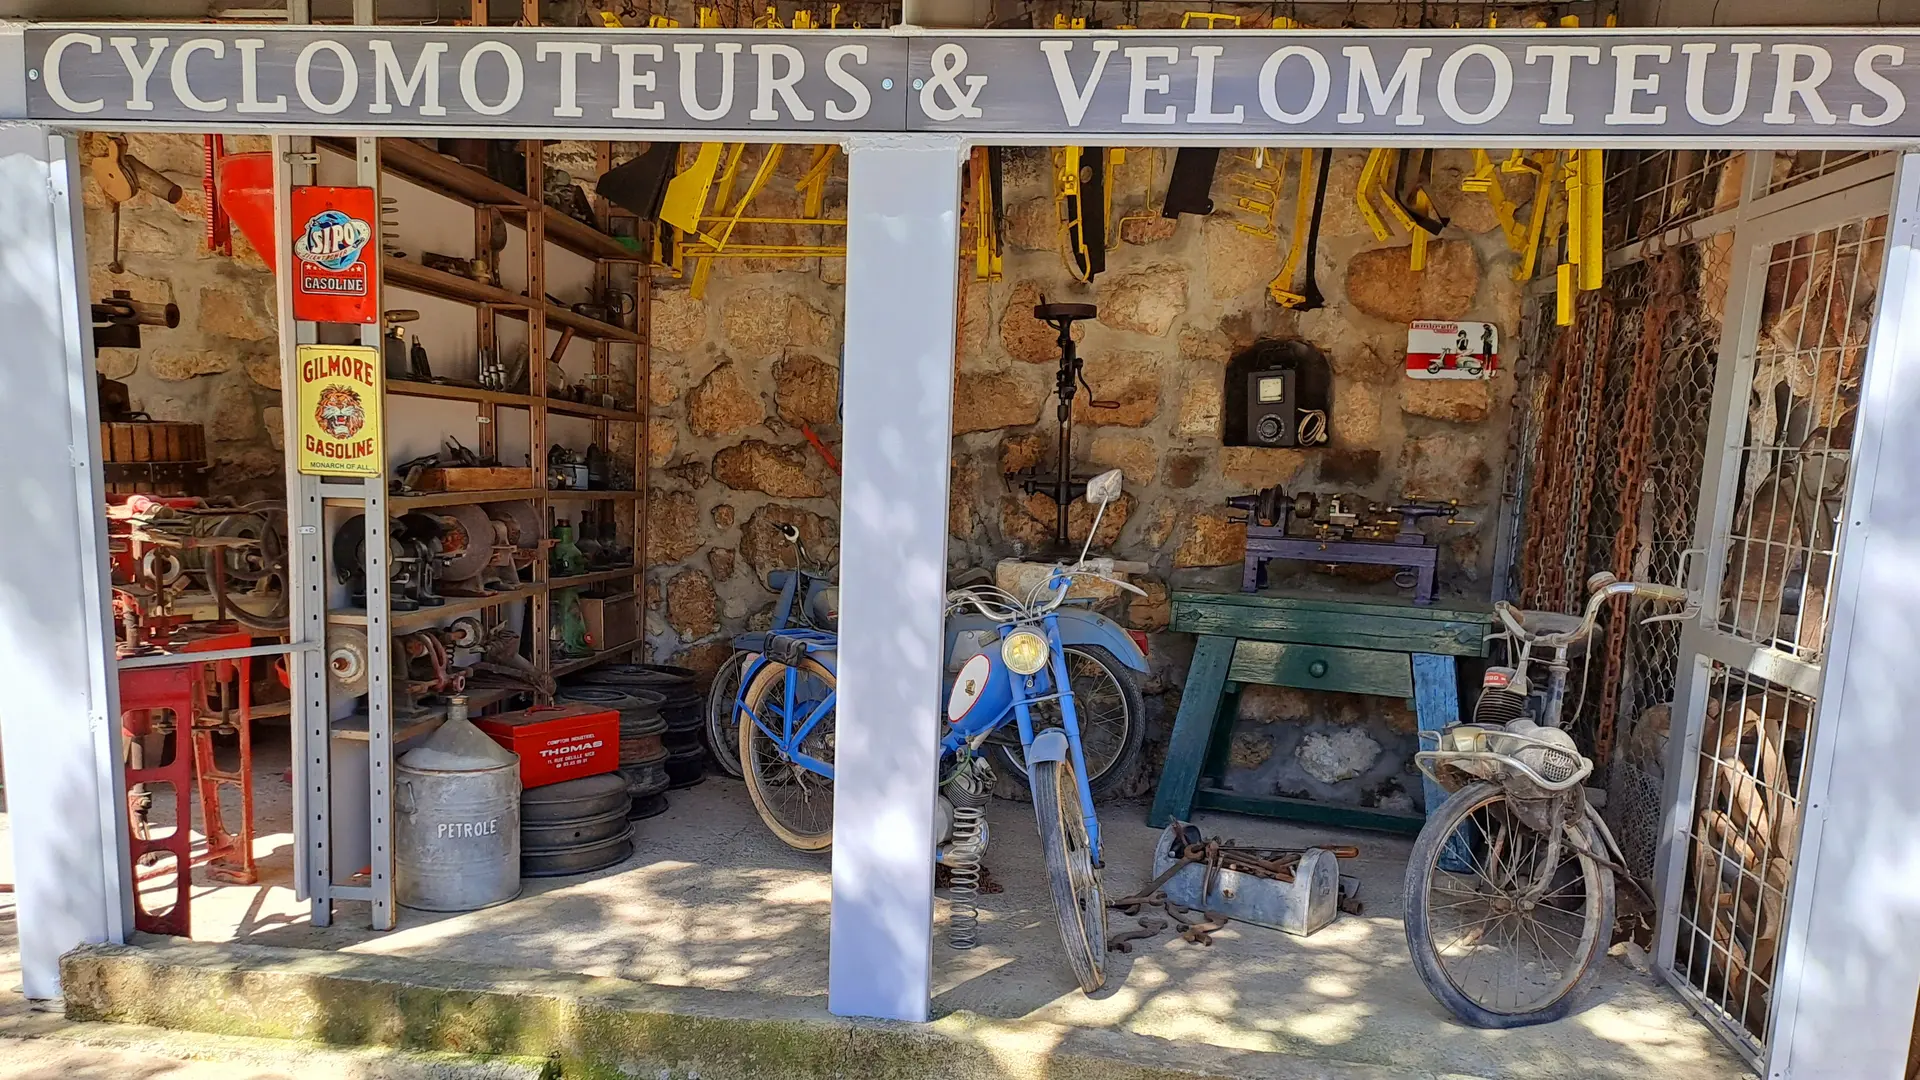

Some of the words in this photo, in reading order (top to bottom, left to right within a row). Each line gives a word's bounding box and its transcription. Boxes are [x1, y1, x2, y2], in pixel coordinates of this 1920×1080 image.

[42, 31, 872, 122] CYCLOMOTEURS
[918, 43, 989, 121] &
[1039, 39, 1907, 128] VELOMOTEURS
[311, 222, 355, 254] SIPO
[305, 277, 363, 291] GASOLINE
[303, 355, 374, 387] GILMORE
[306, 434, 375, 460] GASOLINE
[310, 462, 345, 470] MONARCH
[356, 463, 370, 471] ALL
[539, 740, 603, 757] THOMAS
[437, 819, 497, 839] PETROLE
